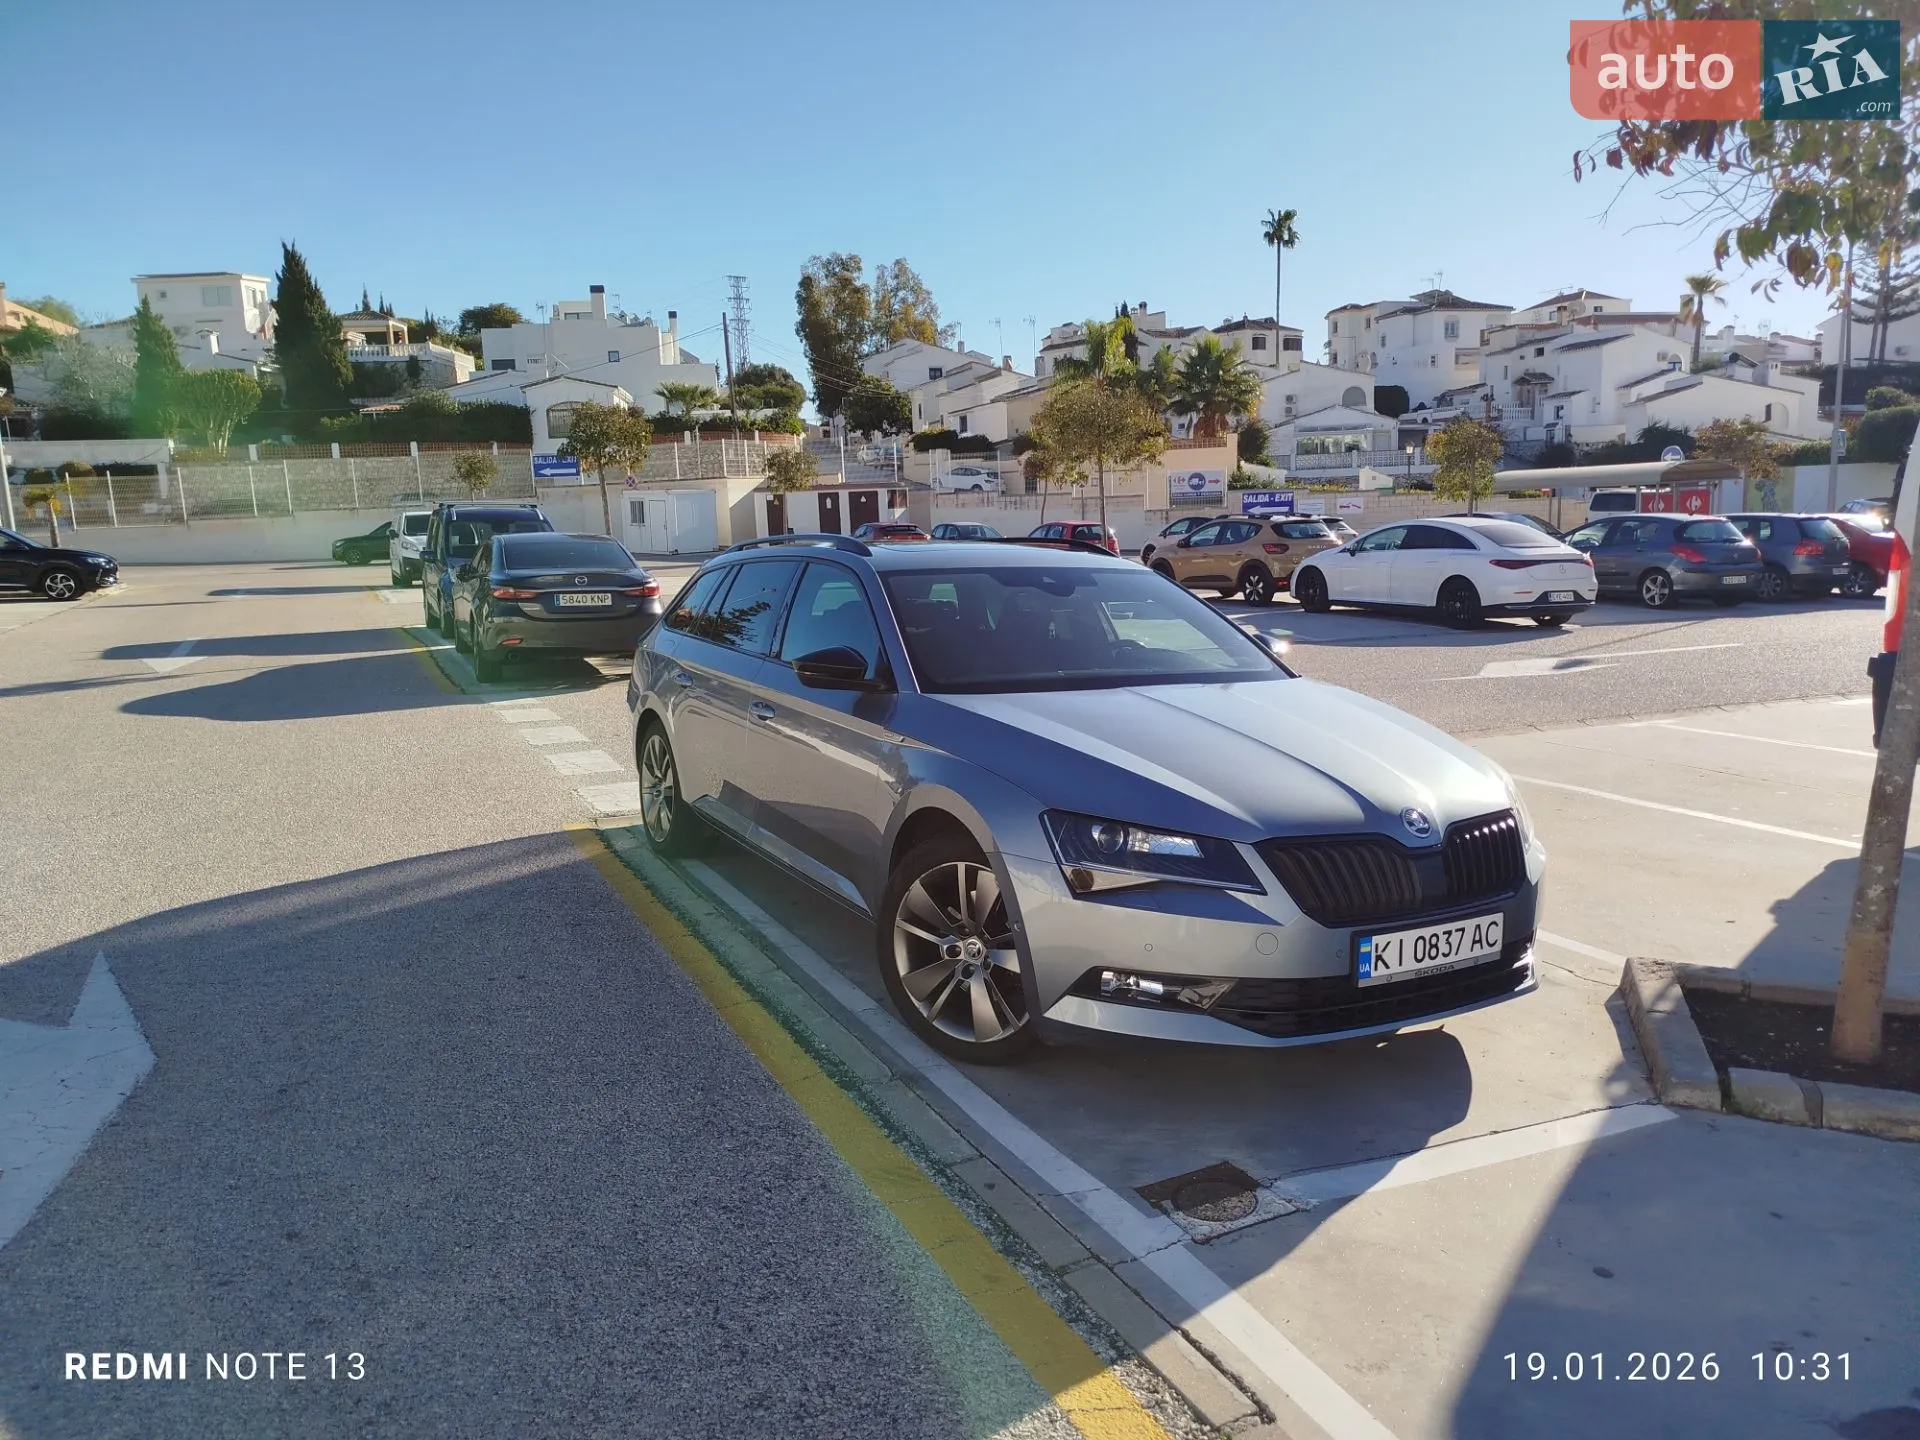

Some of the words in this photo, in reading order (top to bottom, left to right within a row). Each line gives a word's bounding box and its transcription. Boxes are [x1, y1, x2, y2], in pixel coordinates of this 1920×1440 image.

[534, 456, 558, 465] SALIDA
[1243, 494, 1269, 504] SALIDA
[1275, 493, 1294, 503] EXIT
[561, 595, 588, 605] 5840
[590, 595, 610, 604] KNP
[1373, 938, 1403, 972] KI
[1413, 927, 1466, 964] 0837
[1470, 920, 1499, 953] AC
[1359, 962, 1370, 973] UA
